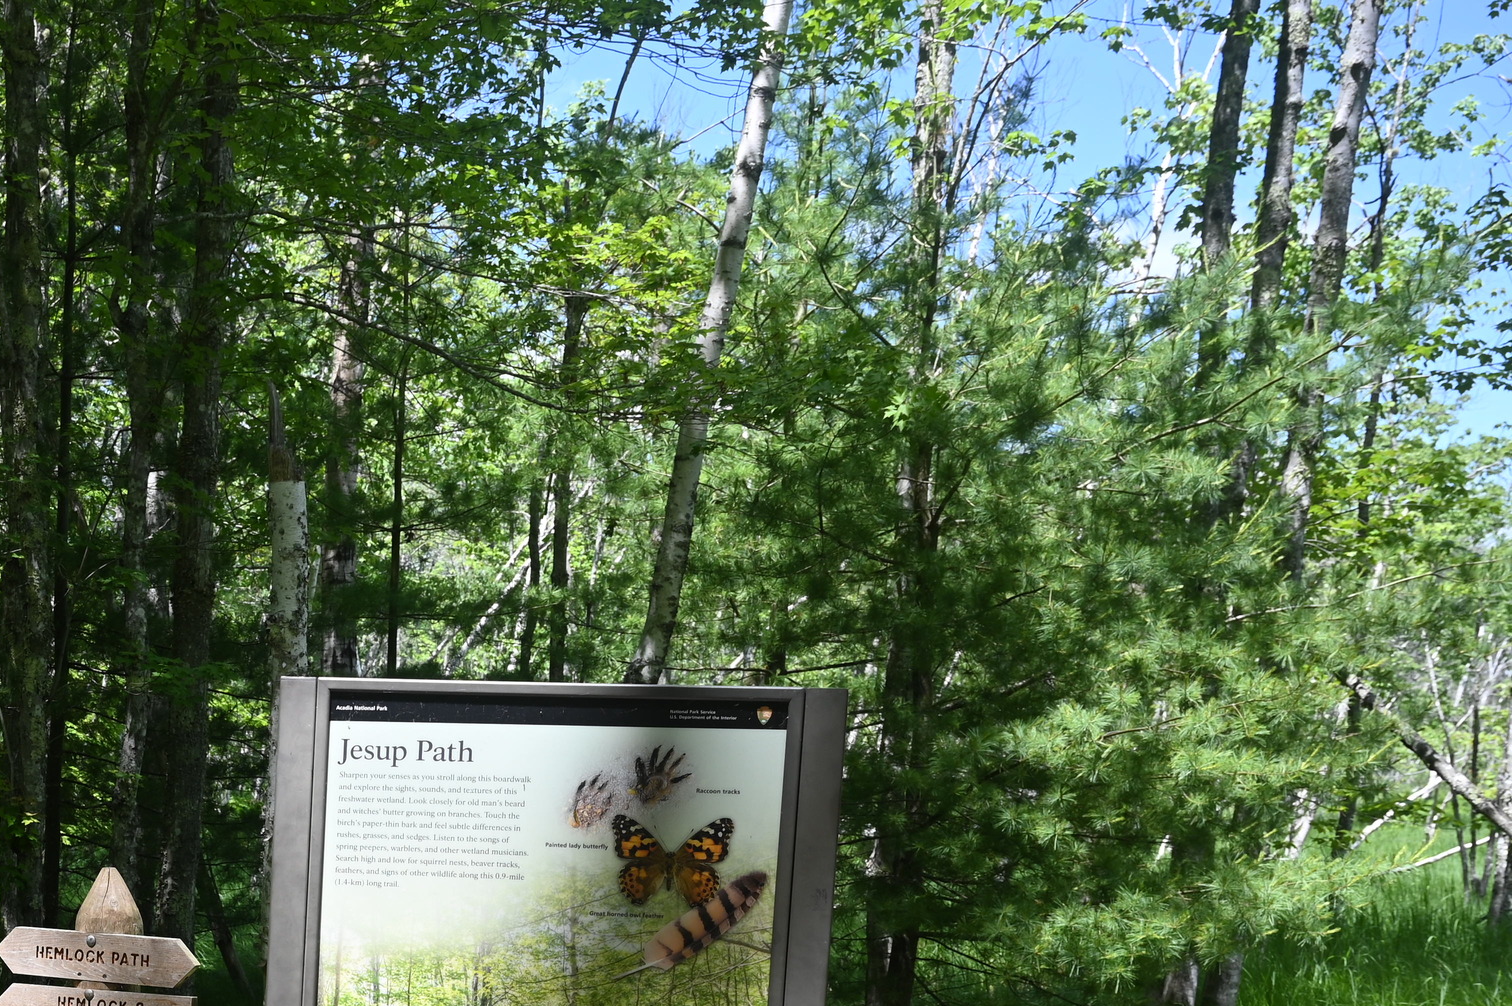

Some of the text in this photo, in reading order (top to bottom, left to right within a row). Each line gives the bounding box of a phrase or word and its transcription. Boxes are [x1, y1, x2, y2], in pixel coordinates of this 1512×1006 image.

[338, 738, 474, 767] Jesup Path
[339, 771, 368, 780] Sharpen
[436, 773, 454, 781] stroll
[456, 774, 476, 783] along
[477, 774, 491, 782] this
[492, 774, 531, 782] boardwalk
[353, 783, 380, 793] explore
[382, 784, 393, 792] the
[395, 784, 416, 794] sights,
[419, 785, 446, 794] sounds,
[463, 786, 492, 794] textures
[338, 795, 374, 803] freshwater
[376, 796, 406, 804] wetland.
[428, 797, 453, 807] closely
[467, 798, 479, 806] old
[504, 799, 525, 807] beard
[382, 808, 404, 816] butter
[405, 809, 435, 818] growing
[447, 810, 482, 818] branches.
[483, 811, 506, 819] Touch
[361, 820, 399, 830] paper-thin
[418, 821, 432, 829] and
[448, 822, 471, 830] subtle
[471, 823, 513, 831] differences
[336, 831, 361, 840] rushes,
[391, 832, 404, 840] and
[406, 833, 431, 842] sedges.
[433, 834, 455, 842] Listen
[456, 834, 464, 842] to
[336, 843, 528, 856] spring peepers, warblers, and other wetland musicians.
[335, 854, 358, 862] Search
[360, 855, 375, 865] high
[377, 856, 391, 864] and
[392, 856, 406, 864] low
[419, 857, 447, 867] squirrel
[448, 858, 469, 868] nests,
[470, 859, 494, 867] beaver
[496, 860, 520, 869] tracks,
[335, 866, 524, 880] feathers, and signs of other wildlife along this 0.9-mile
[334, 879, 400, 889] (1.4-km) long trail.
[36, 946, 150, 967] HEMLOCK PATH
